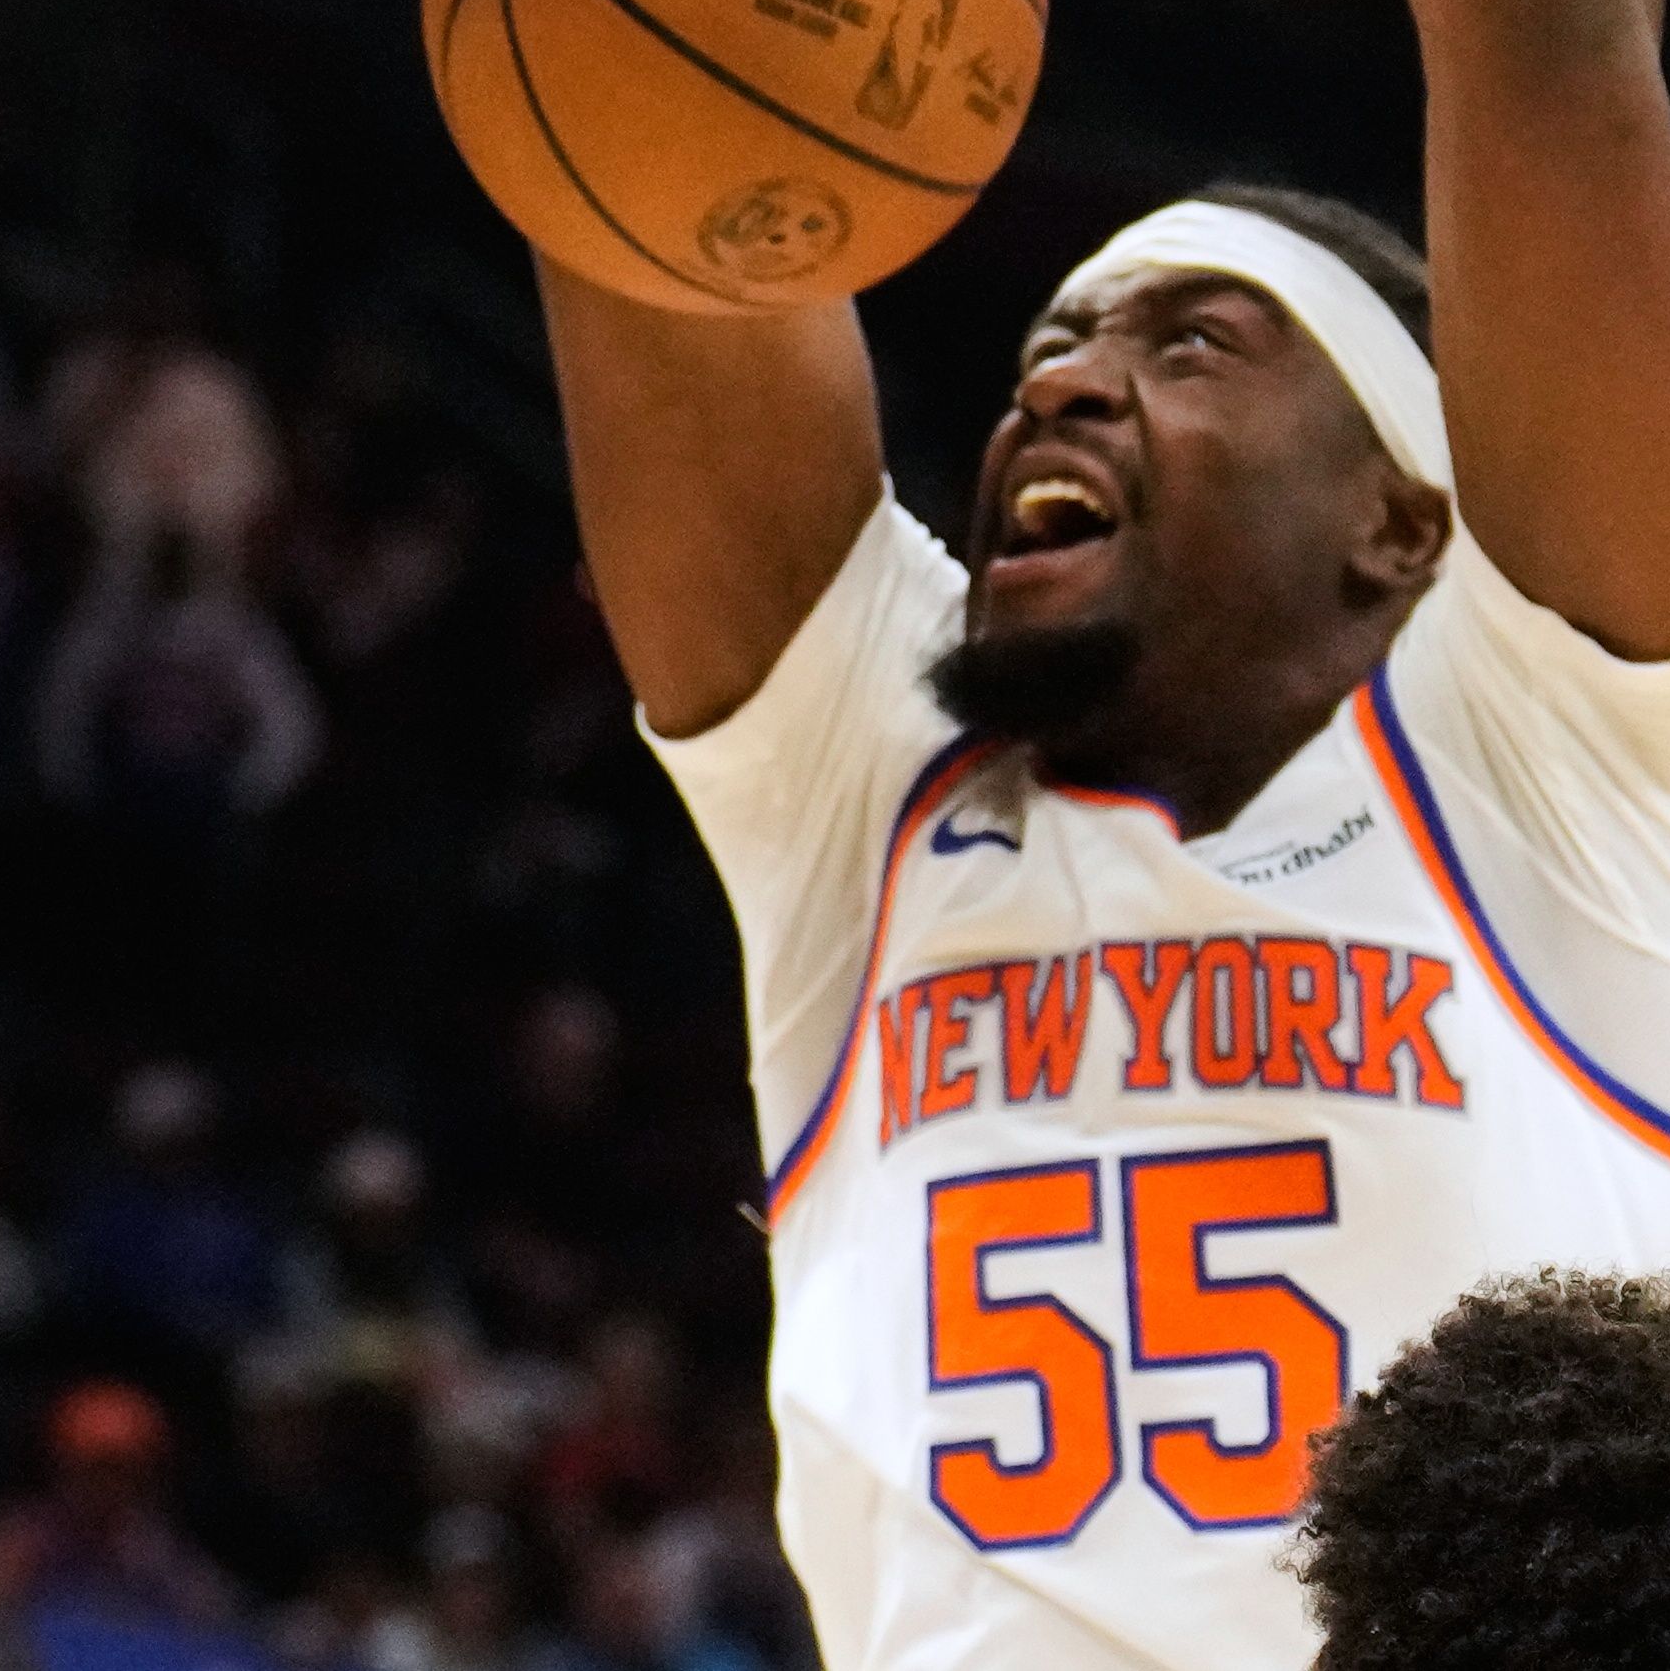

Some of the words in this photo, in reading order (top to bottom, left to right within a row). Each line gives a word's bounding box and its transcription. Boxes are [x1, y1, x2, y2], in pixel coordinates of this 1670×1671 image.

[877, 942, 1095, 1152] NEW
[1101, 935, 1468, 1114] YORK
[927, 1138, 1351, 1552] 55
